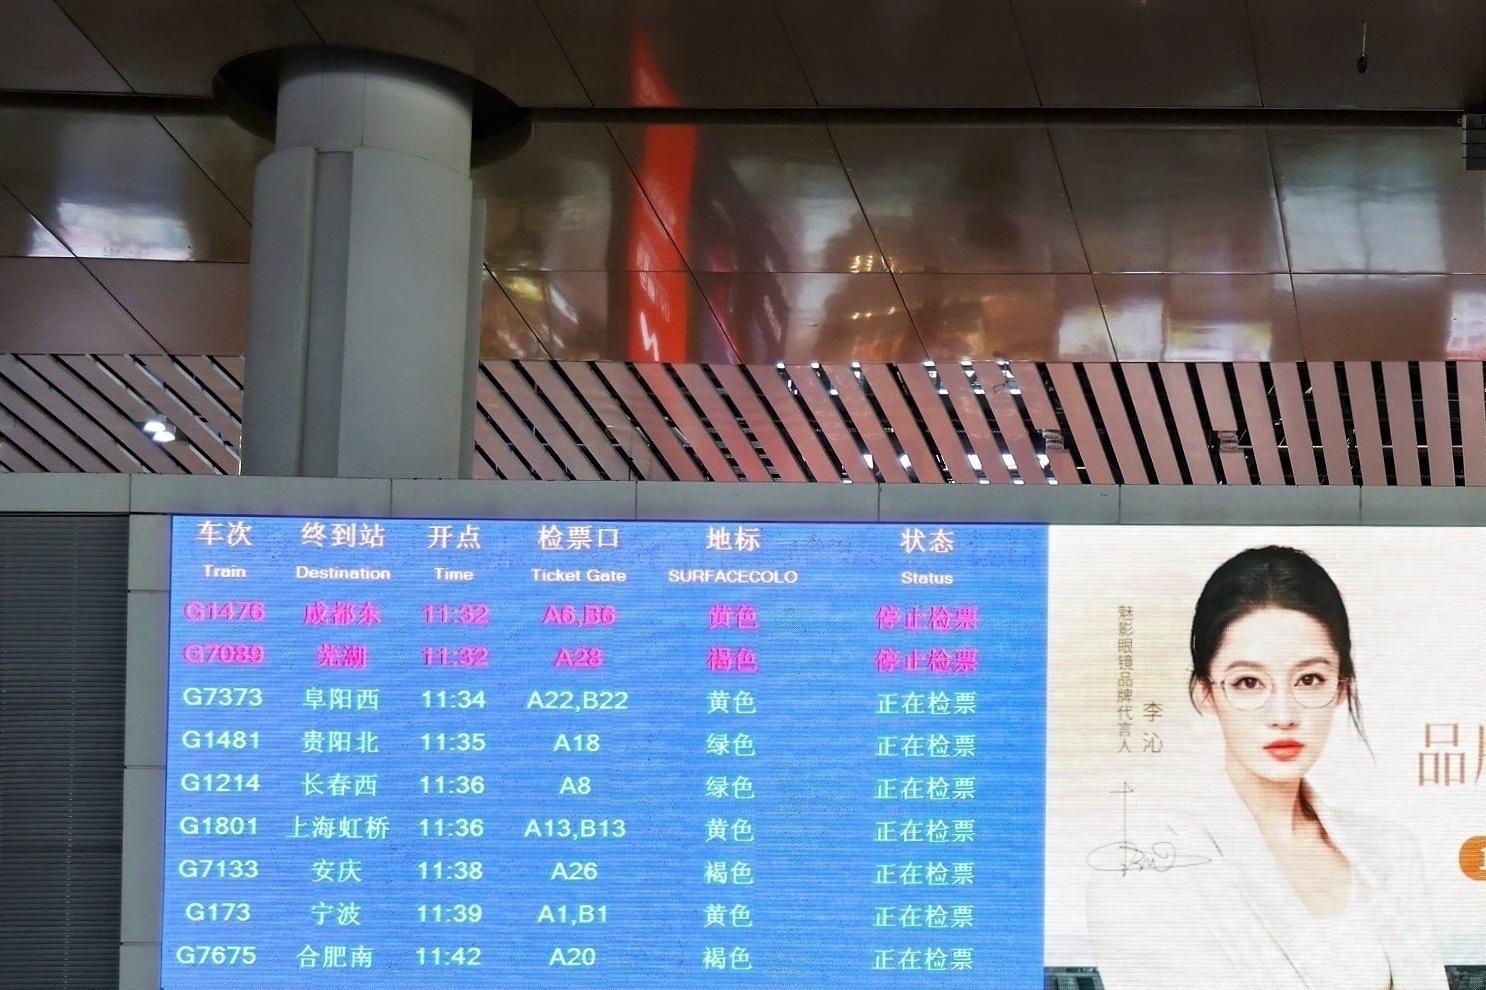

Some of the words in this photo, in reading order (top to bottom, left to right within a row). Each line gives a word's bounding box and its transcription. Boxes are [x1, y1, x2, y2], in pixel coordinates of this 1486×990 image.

[196, 521, 253, 547] 车次
[301, 523, 386, 548] 终到站
[427, 525, 482, 550] 开点
[538, 525, 619, 551] 检票口
[706, 528, 761, 553] 地标
[899, 529, 954, 554] 状态
[204, 564, 246, 578] Train
[295, 566, 391, 580] Destination
[435, 567, 474, 580] Time
[532, 568, 581, 582] Ticket
[586, 569, 627, 582] Gate
[668, 569, 798, 583] SURFACECOLO
[901, 571, 954, 585] Status
[182, 687, 263, 707] G7373
[304, 687, 379, 711] 阜阳西
[422, 690, 486, 709] 11:34
[527, 690, 628, 712] A22,B22
[1142, 701, 1164, 753] 李沁
[181, 730, 259, 749] G1481
[302, 729, 378, 753] 贵阳北
[421, 732, 486, 752] 11:35
[553, 733, 600, 752] A18
[180, 773, 260, 792] G1214
[302, 772, 377, 796] 长春西
[421, 775, 485, 795] 11:36
[560, 776, 591, 795] A8
[179, 816, 257, 835] G1801
[289, 815, 389, 840] 上海虹桥
[419, 818, 484, 837] 11:36
[524, 818, 626, 840] A13,B13
[178, 859, 258, 879] G7133
[312, 859, 361, 883] 安庆
[418, 861, 483, 880] 11:38
[551, 861, 598, 880] A26
[186, 902, 250, 922] G173
[311, 901, 360, 926] 宁波
[418, 904, 483, 923] 11:39
[537, 904, 607, 925] A1,B1
[176, 945, 256, 965] G7675
[297, 944, 372, 968] 合肥南
[417, 947, 481, 966] 11:42
[549, 947, 596, 966] A20
